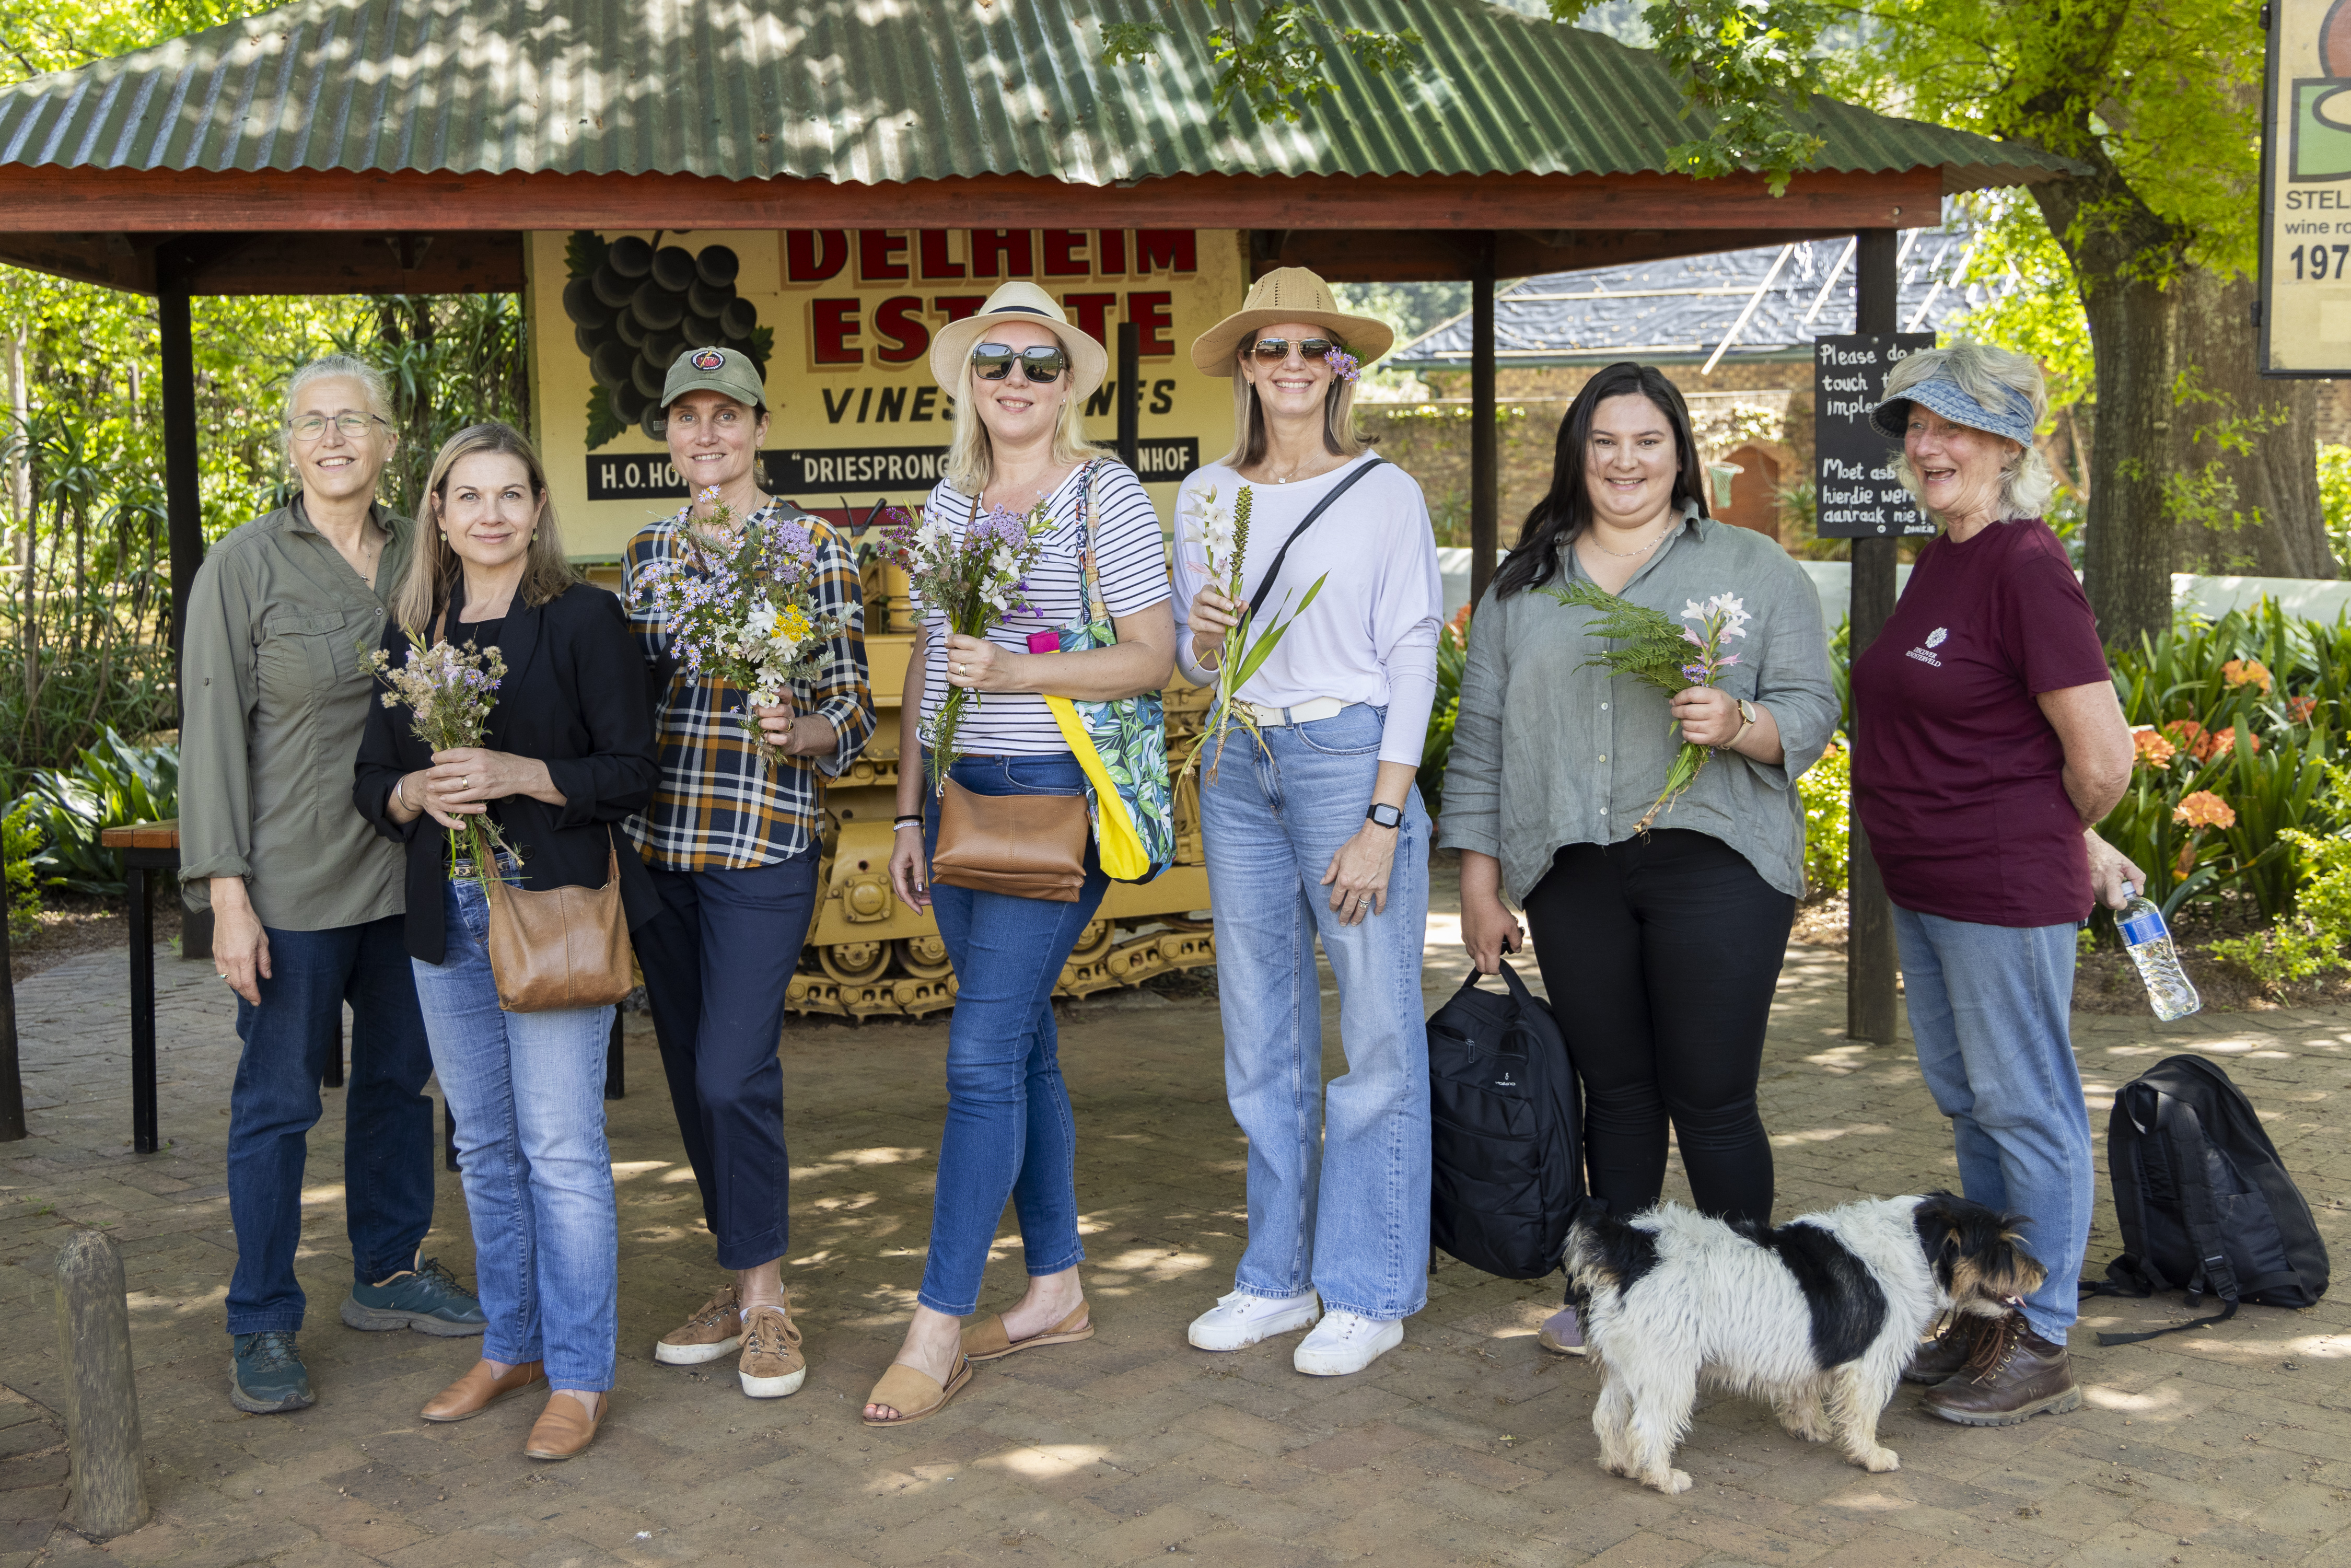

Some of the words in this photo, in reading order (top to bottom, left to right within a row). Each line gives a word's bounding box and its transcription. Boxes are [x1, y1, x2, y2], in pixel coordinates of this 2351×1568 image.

[2286, 190, 2351, 210] STEL
[2286, 219, 2329, 234] wine
[787, 229, 1197, 282] DELHEIM
[812, 291, 1176, 365] ESTTE
[1819, 343, 1877, 366] Please
[1887, 342, 1907, 362] do
[1821, 371, 1869, 392] touch
[1826, 394, 1881, 424] imple
[1822, 458, 1865, 480] Moet
[1870, 464, 1896, 480] asb
[1822, 485, 1873, 505] hierdie
[1823, 505, 1886, 524] aanraak
[1913, 646, 1937, 659] DISCOVER
